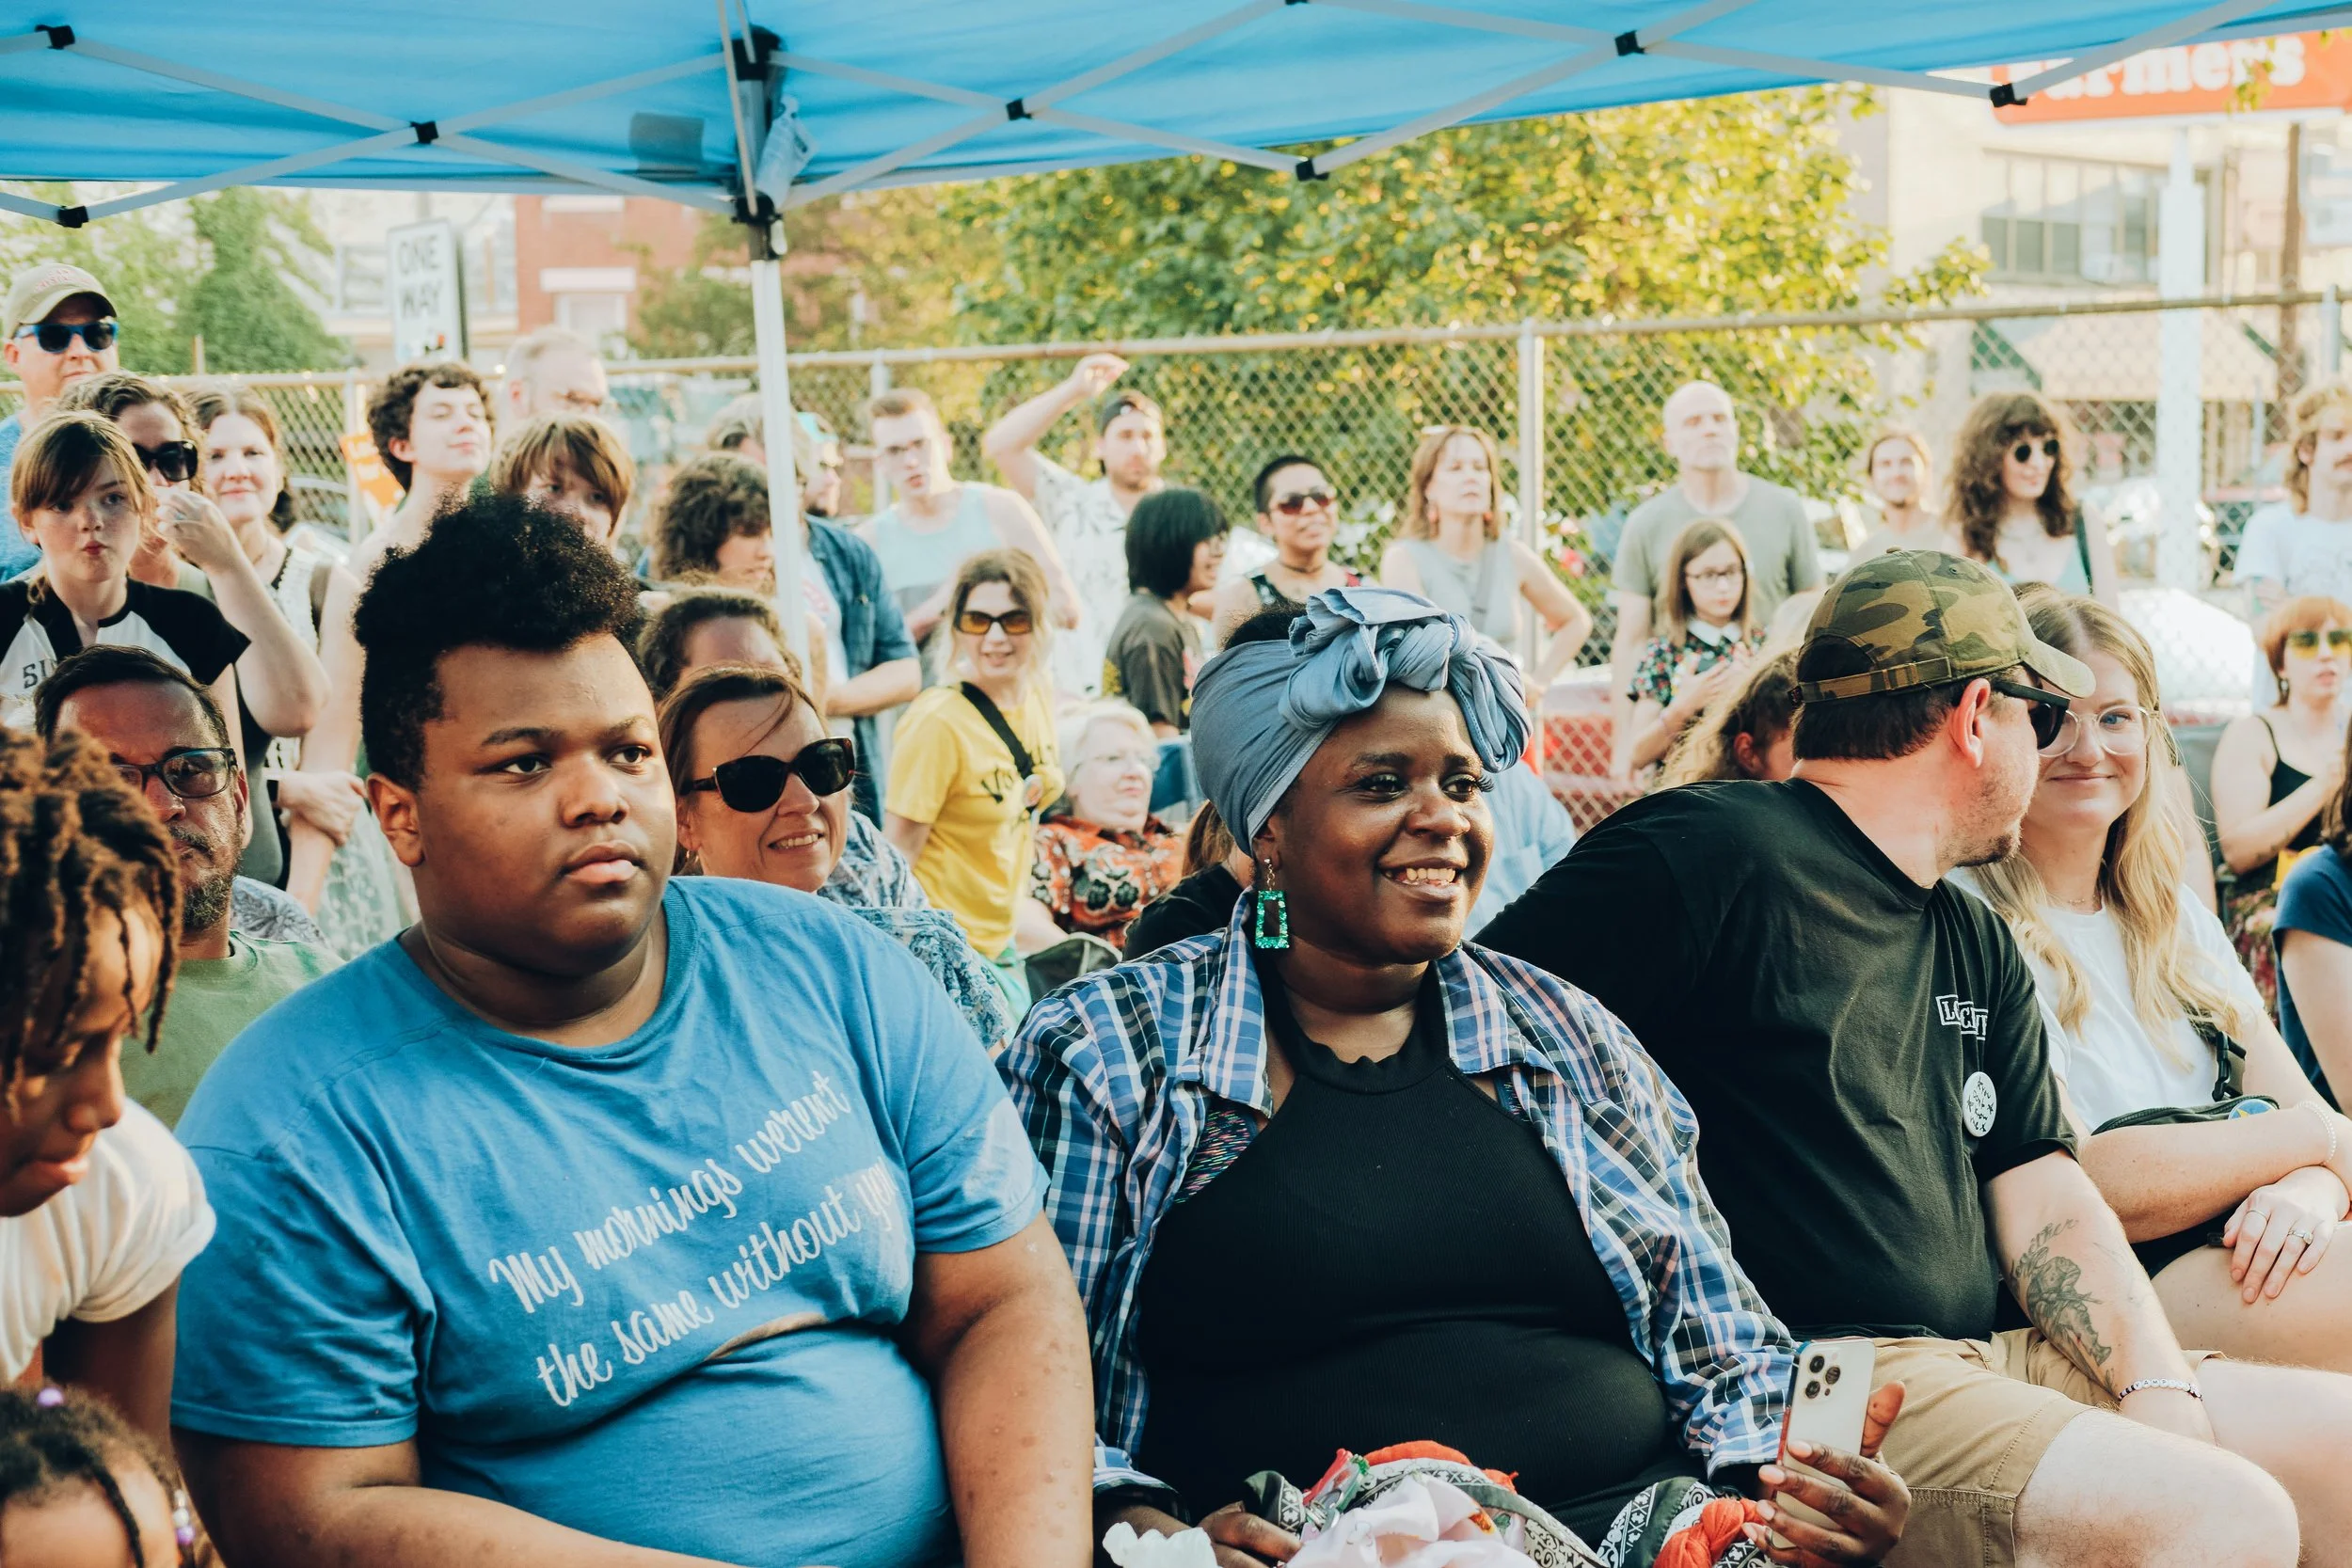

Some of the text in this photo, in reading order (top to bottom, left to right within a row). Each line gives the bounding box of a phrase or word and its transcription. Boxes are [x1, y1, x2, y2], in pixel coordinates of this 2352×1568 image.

[398, 233, 440, 276] ONE
[399, 279, 442, 319] WAY
[488, 1245, 585, 1314] My
[573, 1158, 742, 1270] mornings
[536, 1343, 613, 1407] the
[611, 1290, 715, 1365] same
[707, 1185, 862, 1309] without
